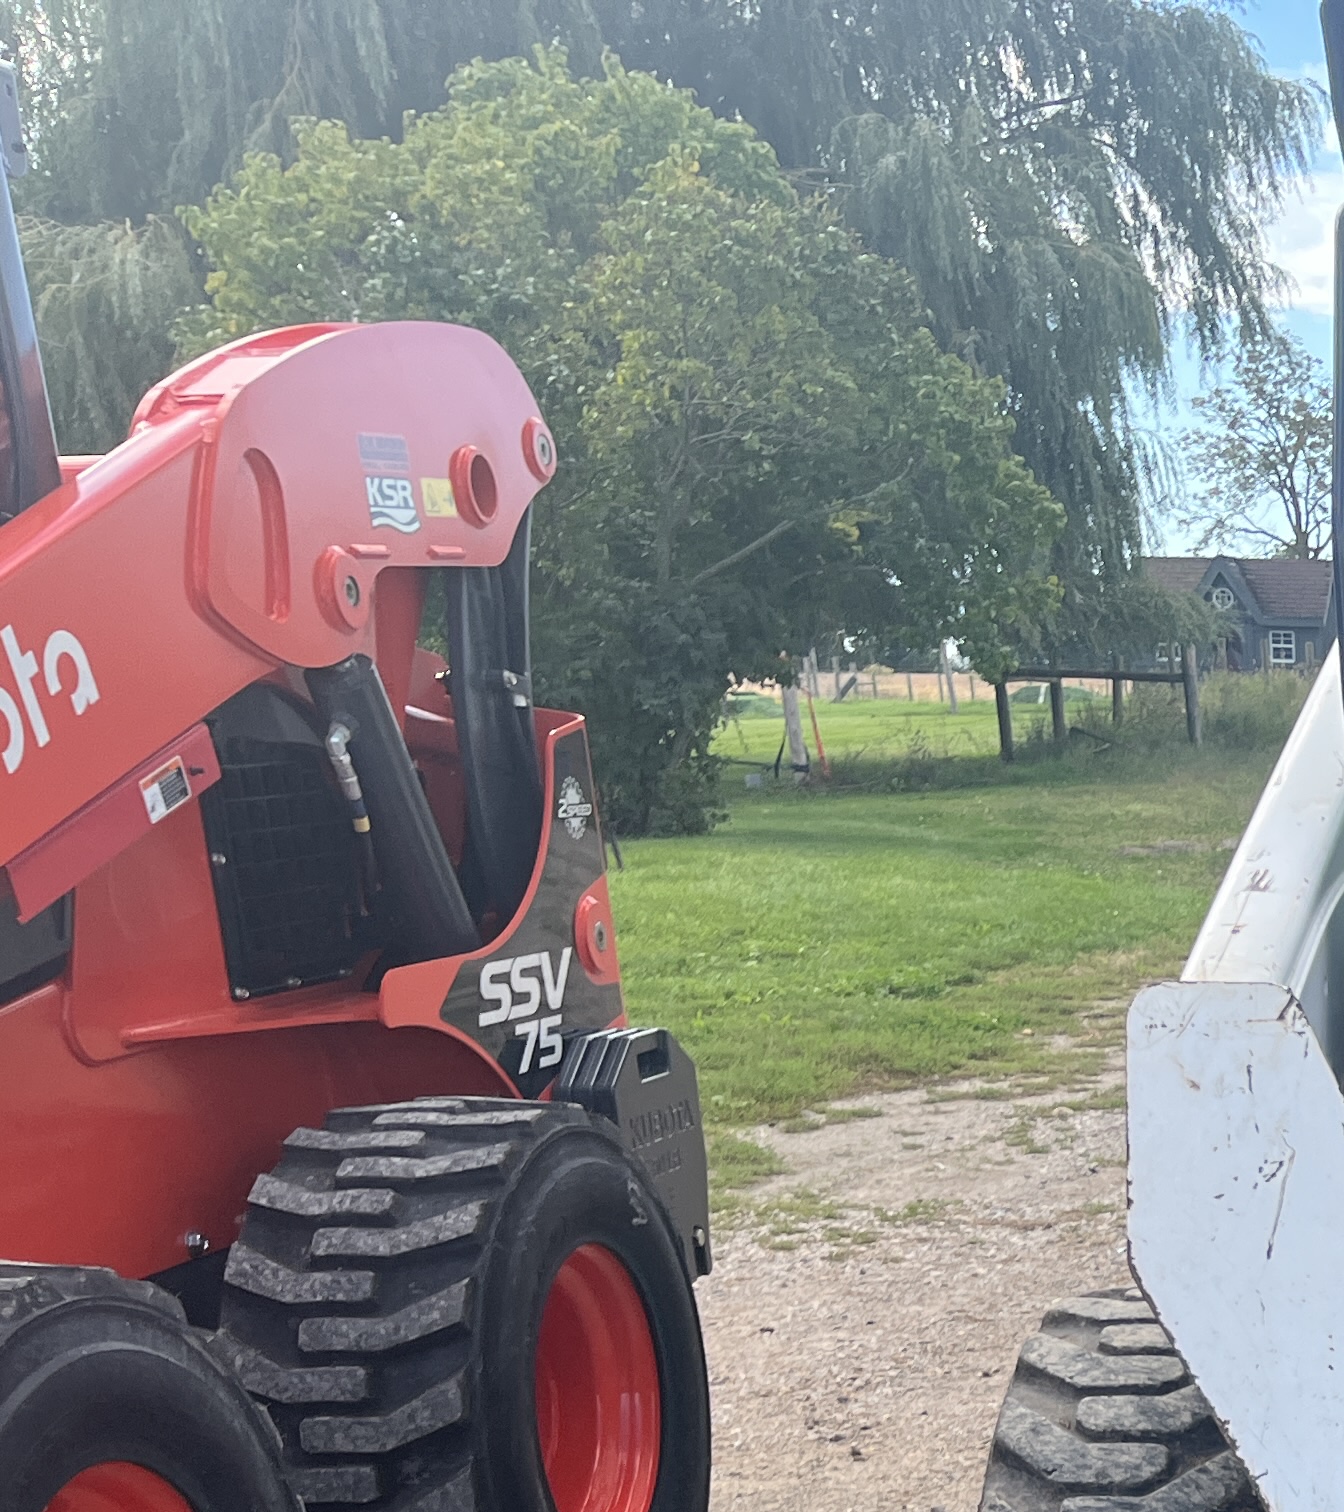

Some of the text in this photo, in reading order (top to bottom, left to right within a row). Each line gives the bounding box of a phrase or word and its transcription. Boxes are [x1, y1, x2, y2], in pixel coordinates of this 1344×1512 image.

[365, 477, 415, 508] KSR
[479, 946, 572, 1027] SSV
[515, 1014, 563, 1075] 75
[629, 1100, 695, 1151] KUBOTA
